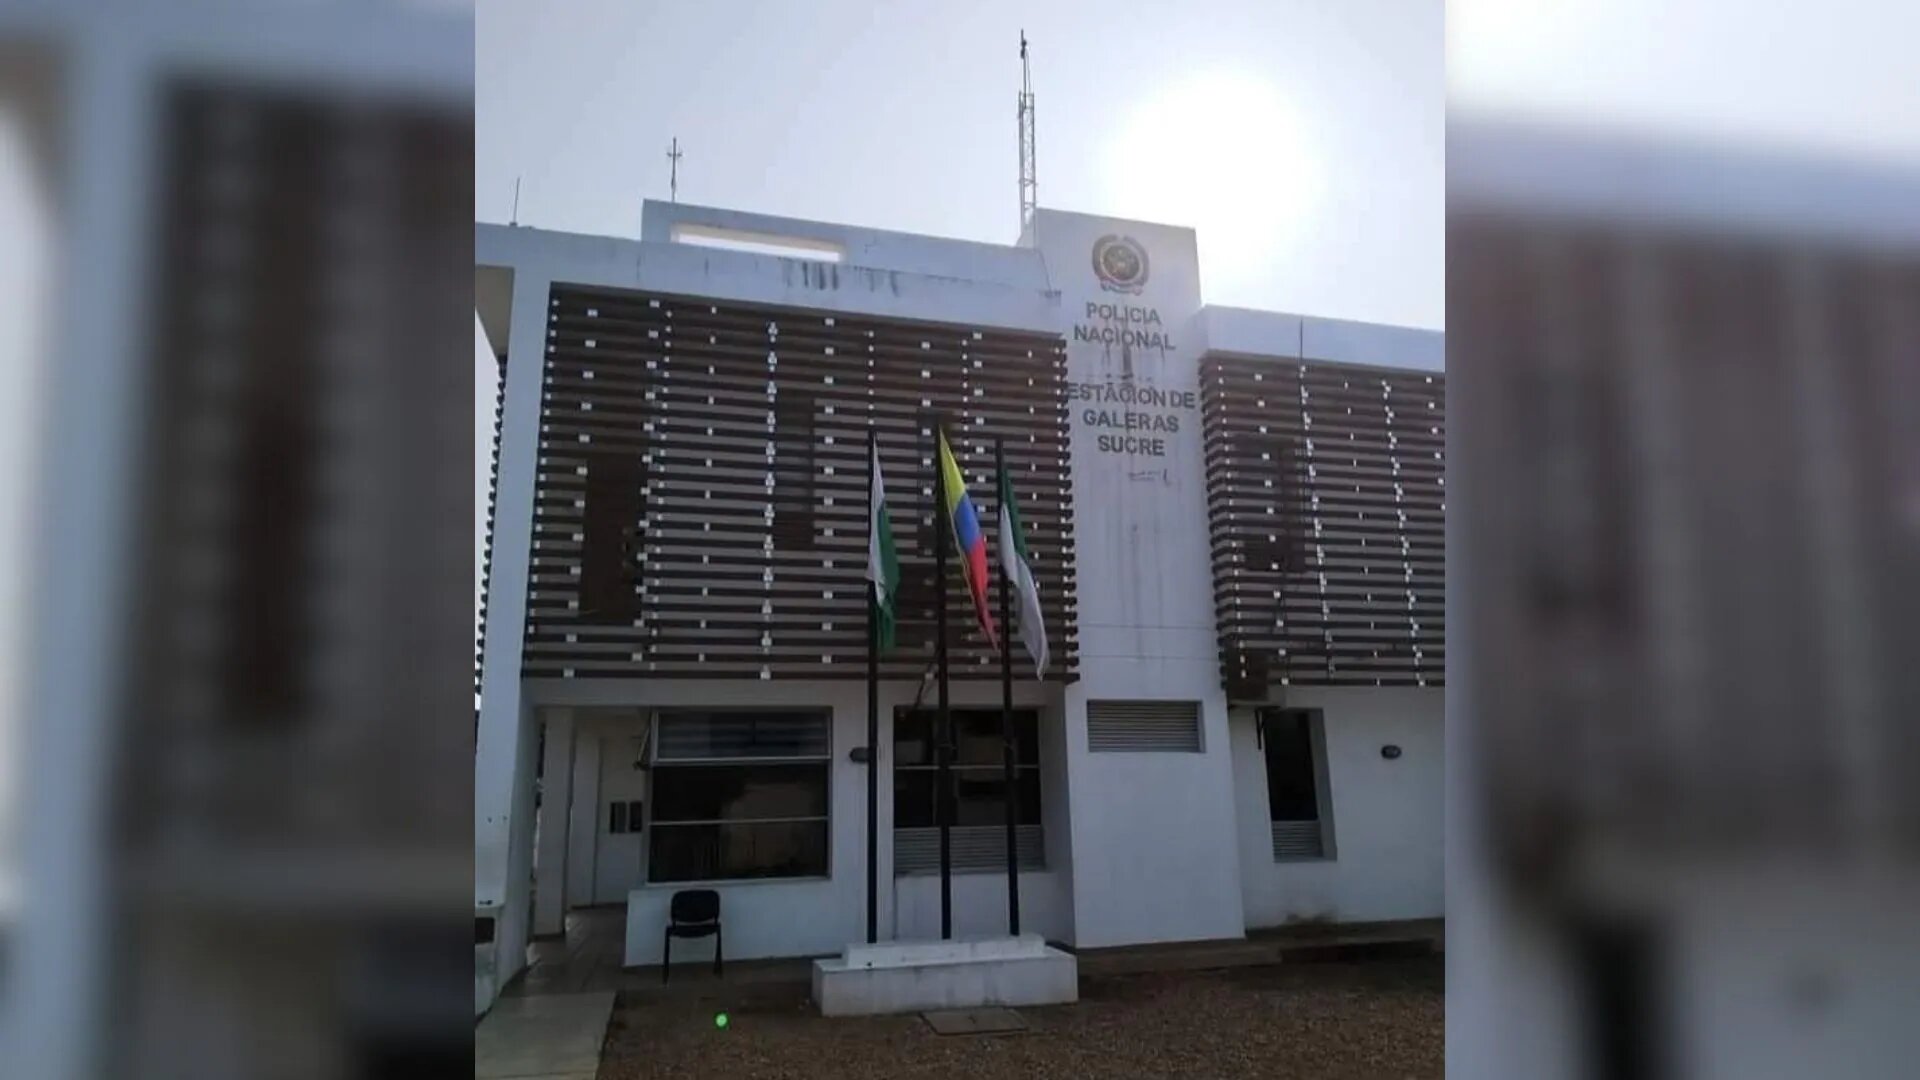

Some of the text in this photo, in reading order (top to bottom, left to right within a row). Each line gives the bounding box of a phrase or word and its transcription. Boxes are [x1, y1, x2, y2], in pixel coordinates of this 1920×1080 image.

[1086, 302, 1162, 325] POLICIA
[1074, 324, 1176, 350] NACIONAL
[1170, 391, 1195, 409] DE
[1083, 408, 1180, 432] GALERAS
[1098, 434, 1165, 456] SUCRE
